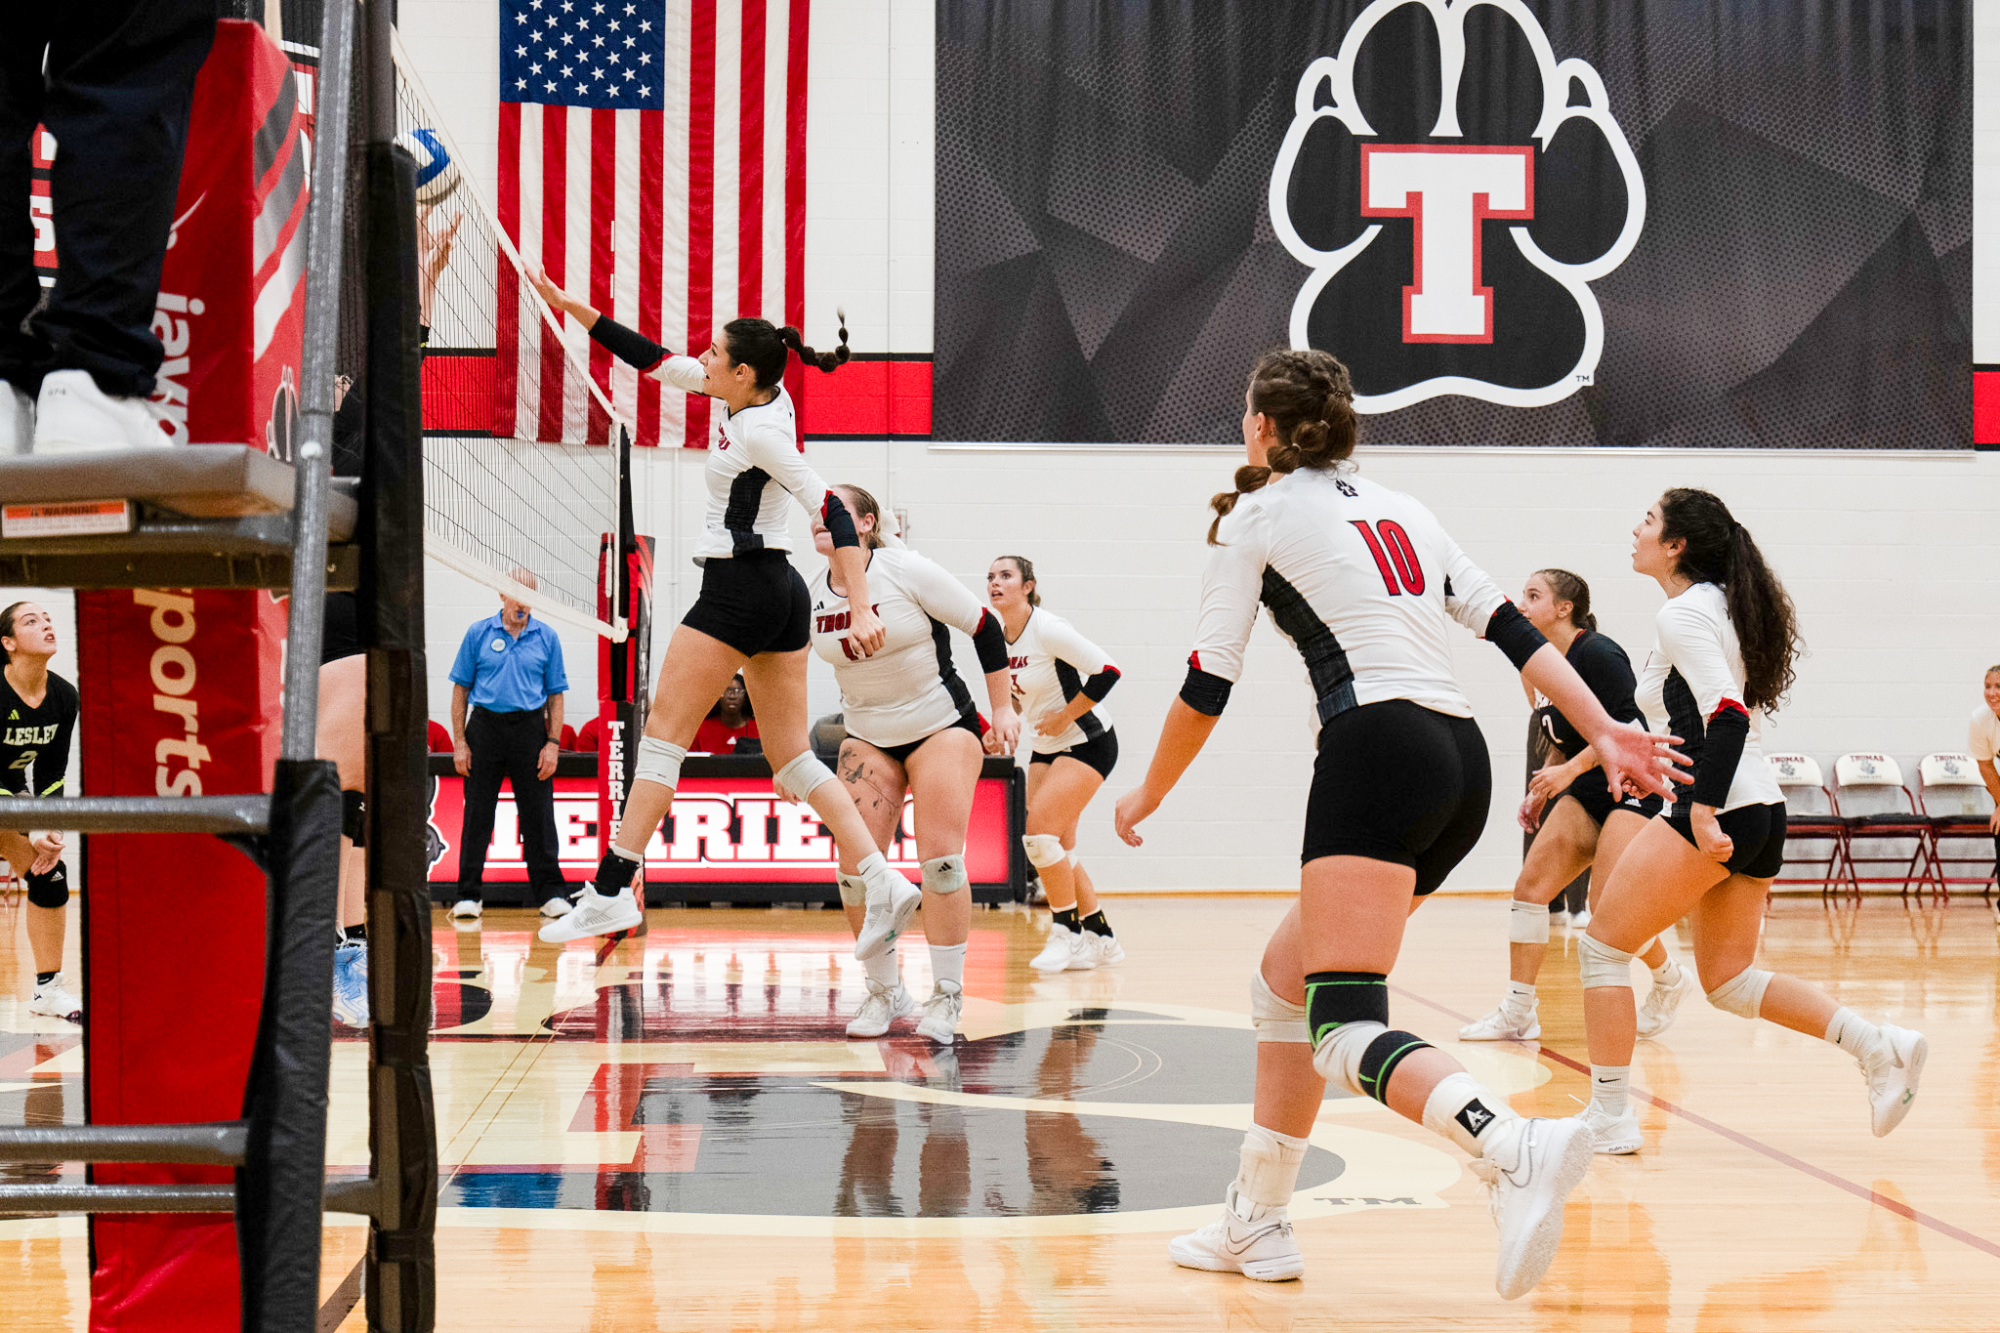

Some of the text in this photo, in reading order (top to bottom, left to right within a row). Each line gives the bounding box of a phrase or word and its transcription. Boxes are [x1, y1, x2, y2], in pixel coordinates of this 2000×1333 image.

[1361, 143, 1534, 344] T
[1346, 519, 1426, 597] 10
[132, 586, 212, 797] ports
[3, 723, 60, 746] LESLEY
[8, 750, 39, 769] 2
[607, 721, 626, 850] TERRIE
[1313, 1197, 1423, 1206] TM
